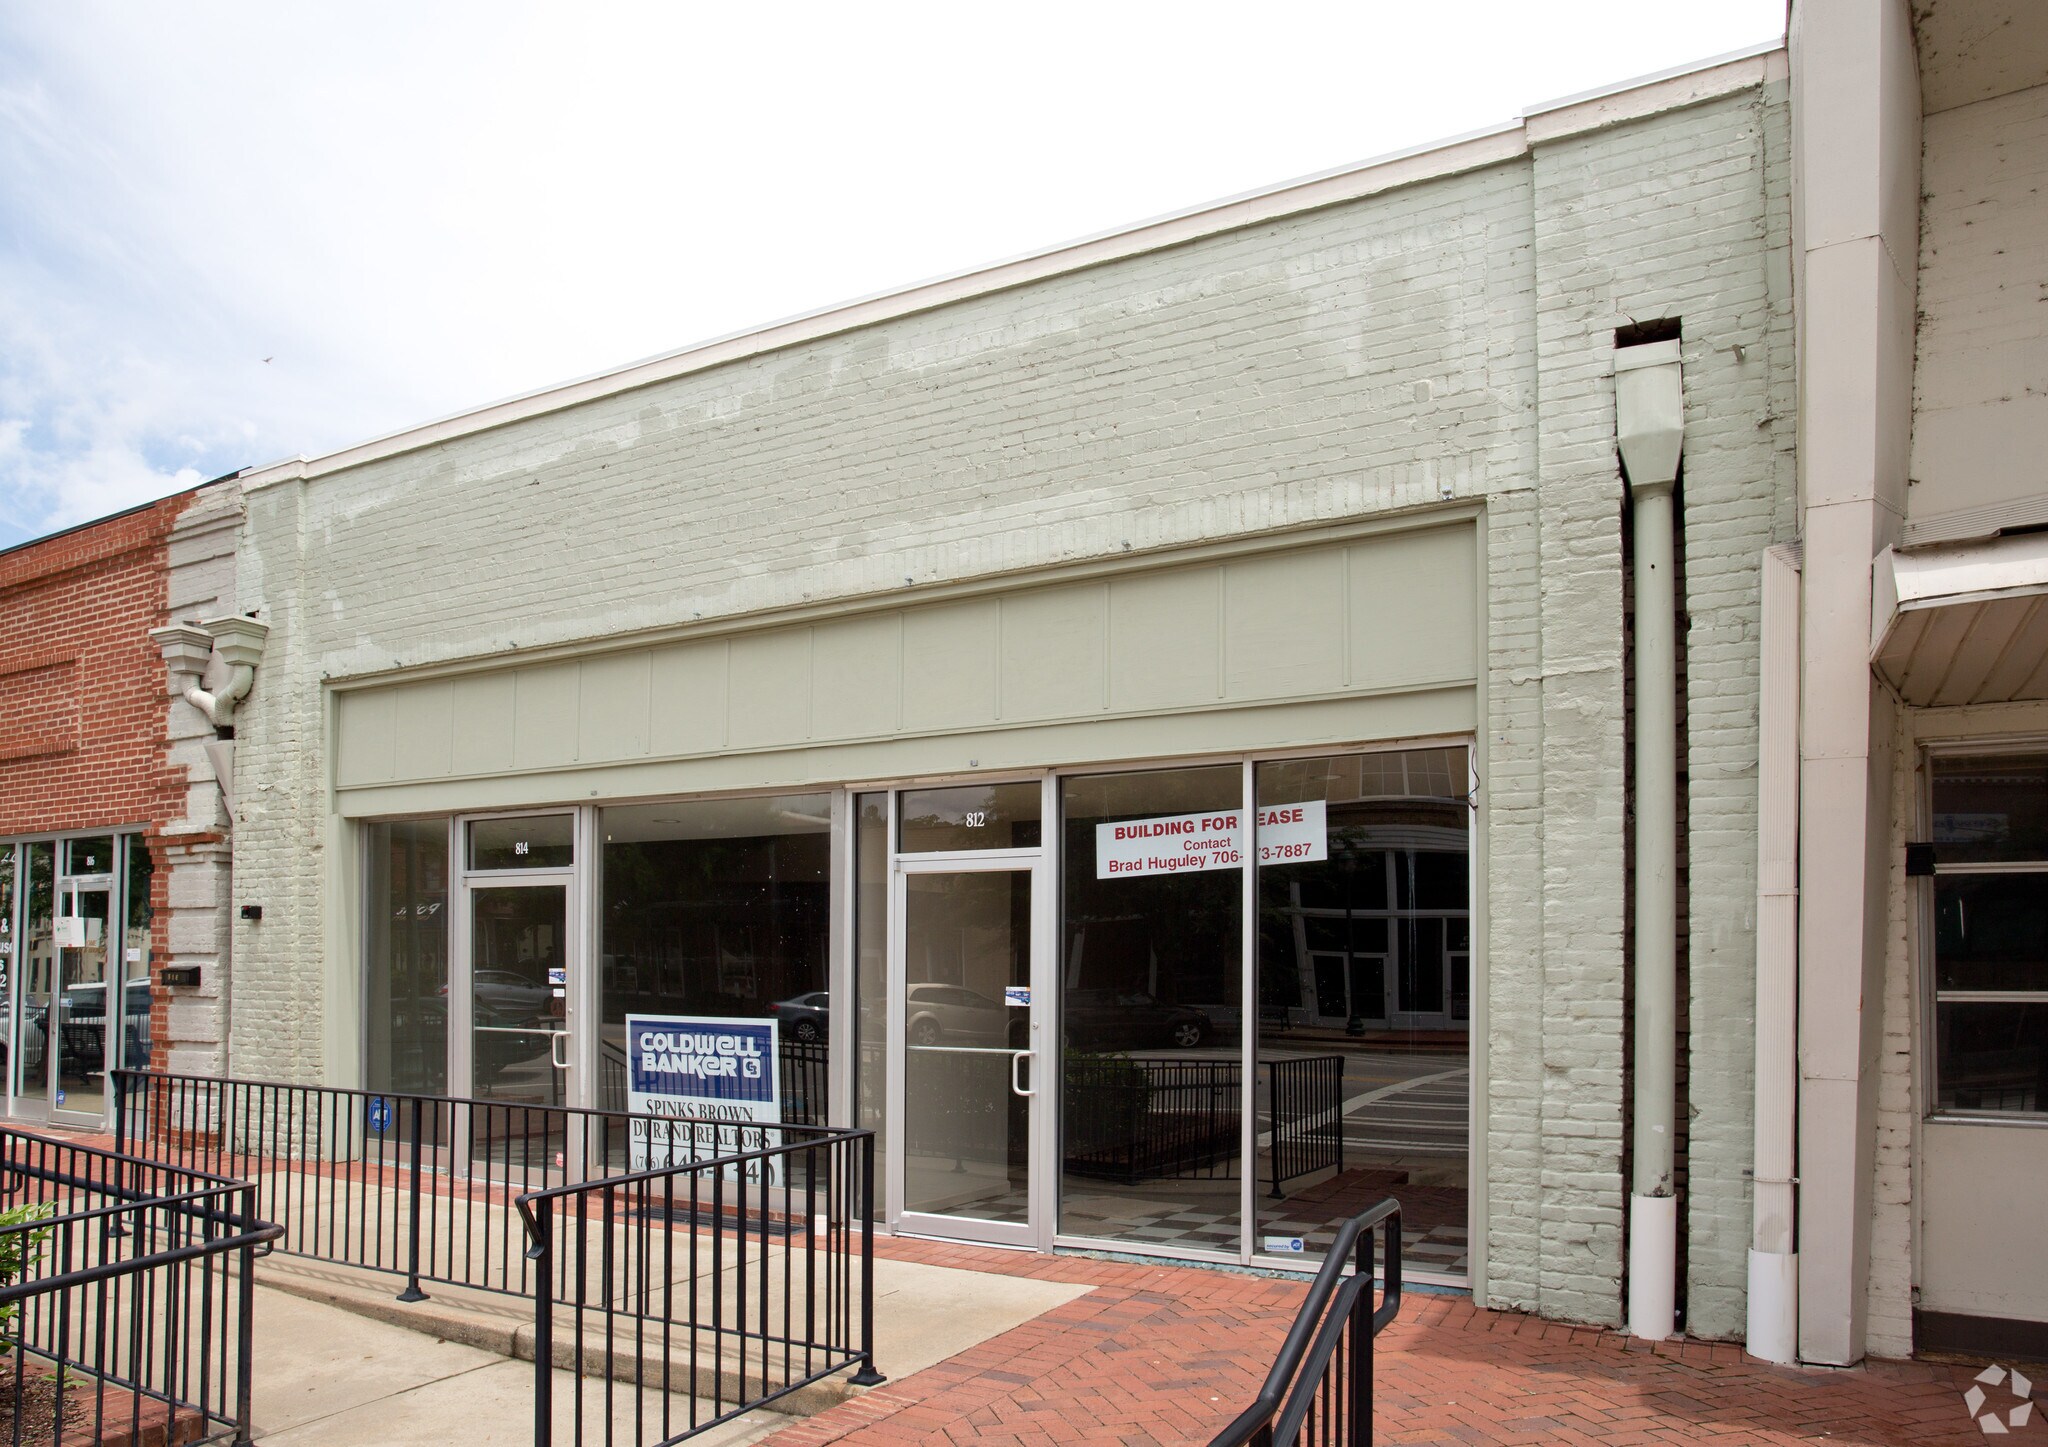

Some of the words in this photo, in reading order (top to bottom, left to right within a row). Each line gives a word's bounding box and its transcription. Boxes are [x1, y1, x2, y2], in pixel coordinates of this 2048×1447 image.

[966, 811, 985, 828] 812
[1114, 820, 1195, 841] BUILDING
[1201, 815, 1238, 832] FOR
[1257, 808, 1304, 827] EASE
[515, 841, 529, 855] 814
[1183, 836, 1232, 851] Contact
[1109, 858, 1143, 873] Brad
[1148, 852, 1207, 871] Huguley
[1211, 842, 1313, 864] 706-3-7887
[640, 1031, 762, 1057] COLDWELL
[642, 1052, 738, 1080] BANKER
[373, 1108, 388, 1120] AT
[646, 1099, 695, 1119] SPINKS
[698, 1103, 753, 1122] BROWN
[634, 1154, 660, 1169] (76)
